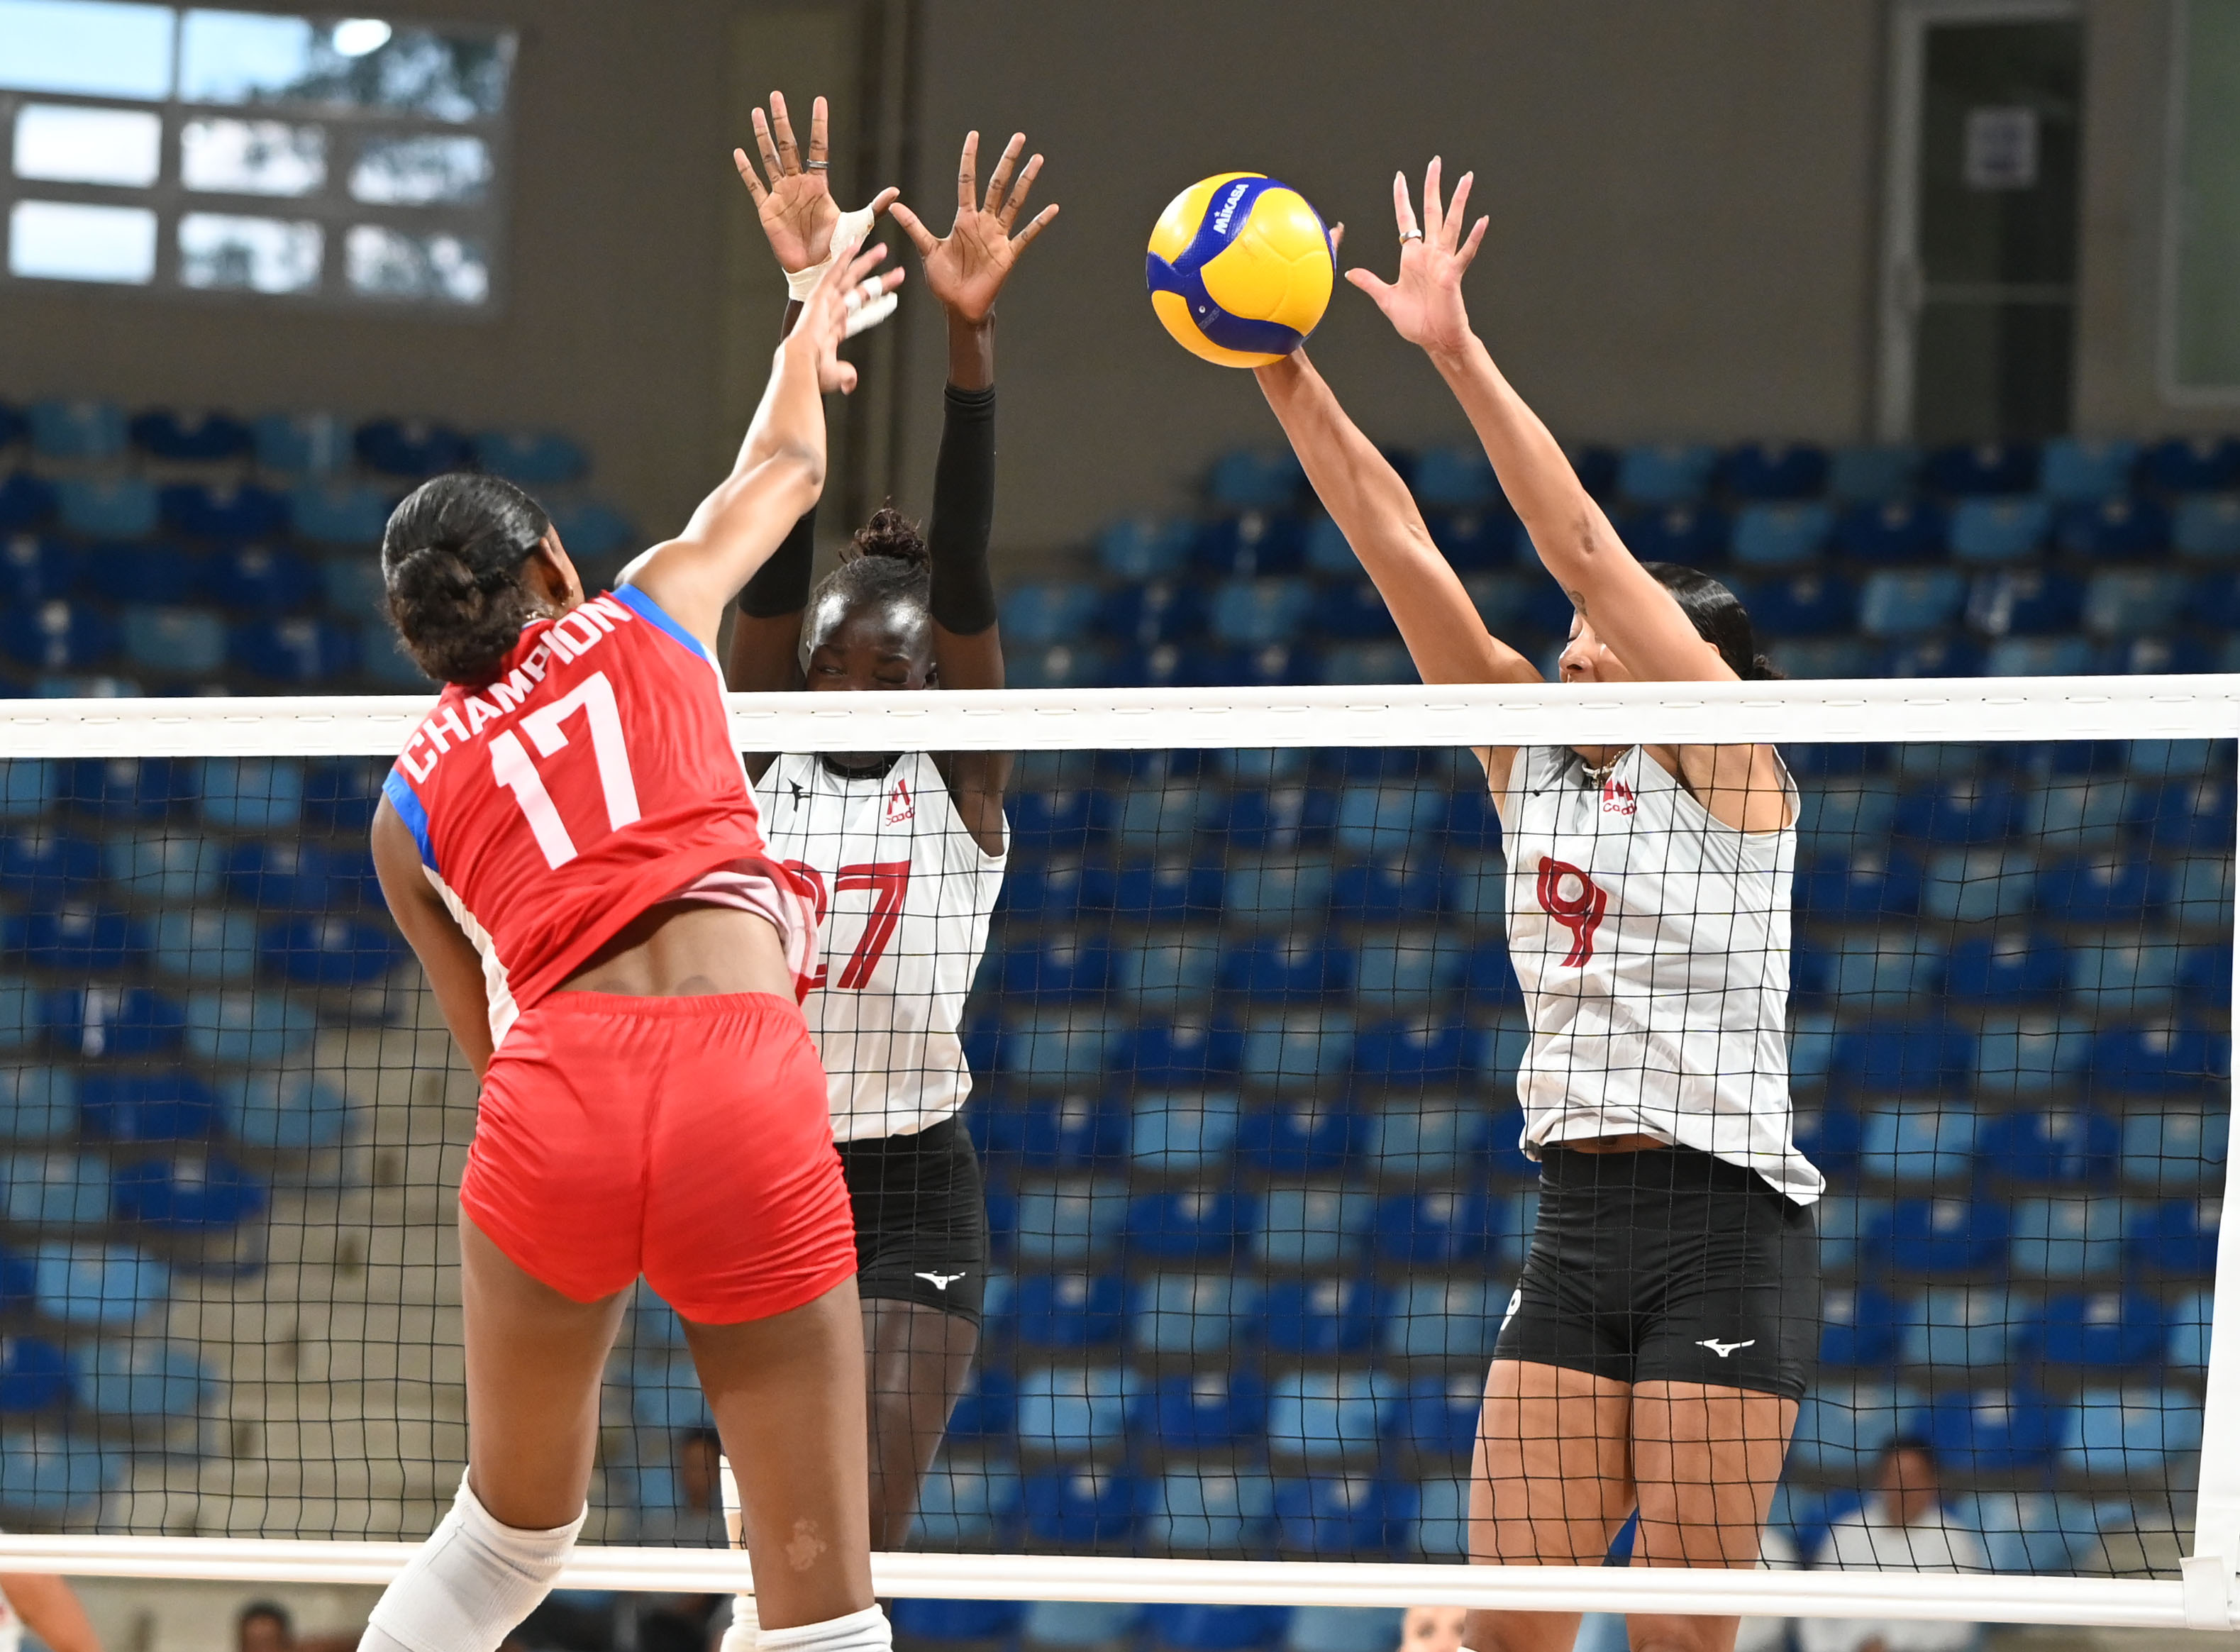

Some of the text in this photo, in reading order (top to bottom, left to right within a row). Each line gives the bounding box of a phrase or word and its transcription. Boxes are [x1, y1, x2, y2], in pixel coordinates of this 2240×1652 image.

[401, 597, 633, 784] CHAMPION
[489, 670, 641, 871] 17
[1536, 855, 1607, 968] 9
